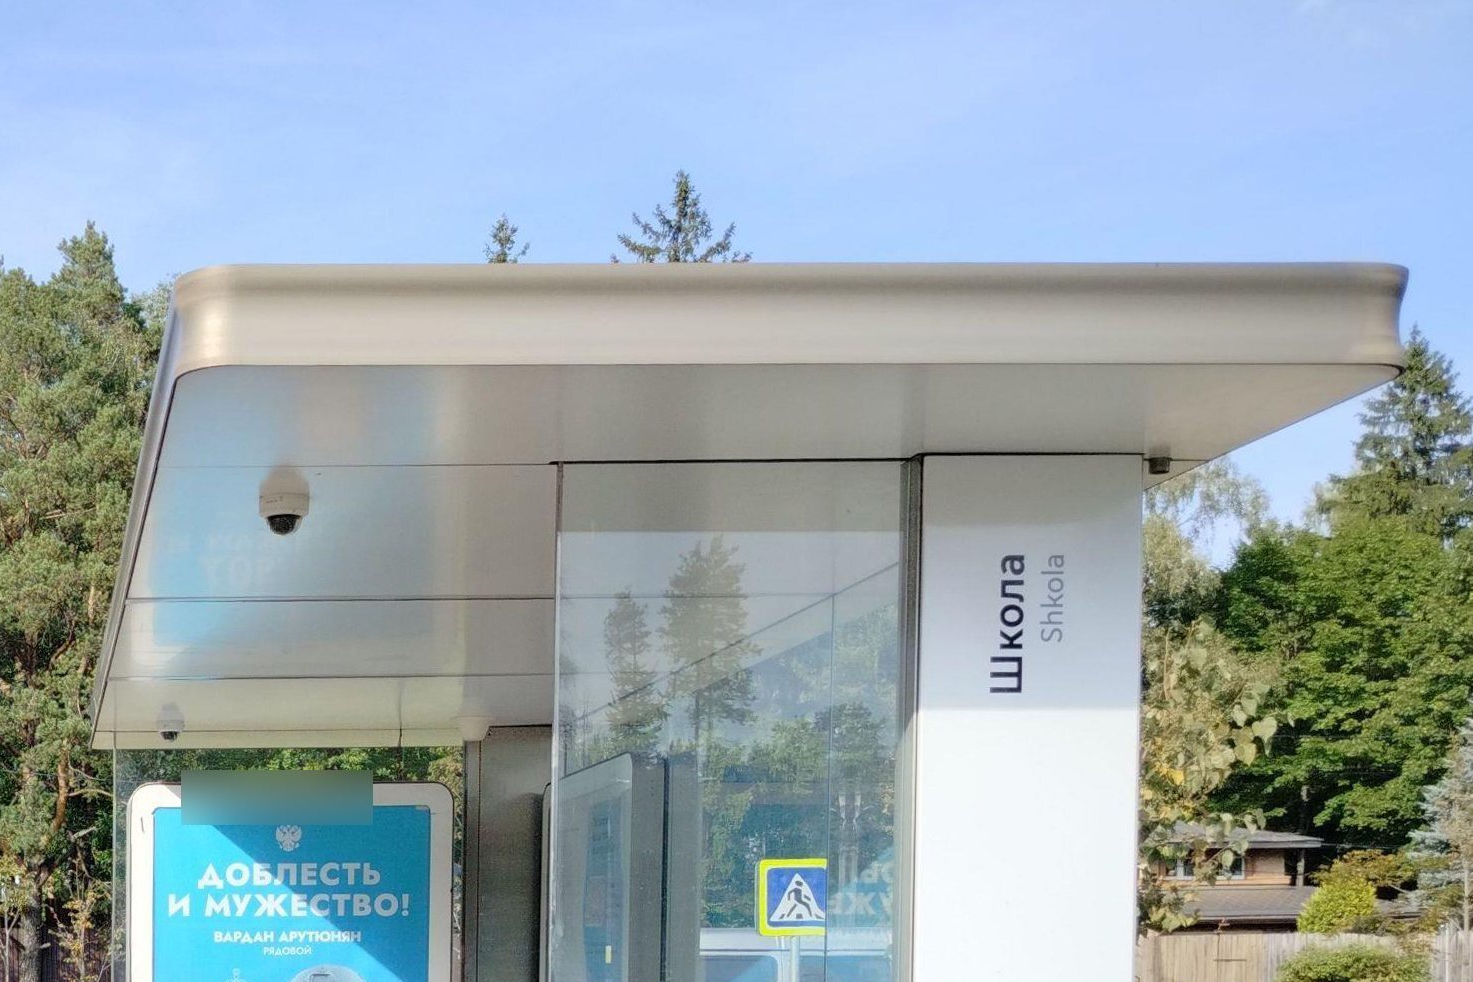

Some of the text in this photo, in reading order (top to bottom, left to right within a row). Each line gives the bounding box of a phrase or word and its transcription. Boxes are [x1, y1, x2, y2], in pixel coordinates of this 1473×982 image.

[1039, 554, 1065, 643] Shkola
[989, 554, 1025, 693] Школа
[197, 862, 381, 890] ДОБЛЕСТЬ
[168, 893, 410, 917] И МУЖЕСТВО!
[213, 930, 362, 944] ВАРДАН АРУТЮНЯН
[263, 945, 312, 957] РЯДОВОЙ
